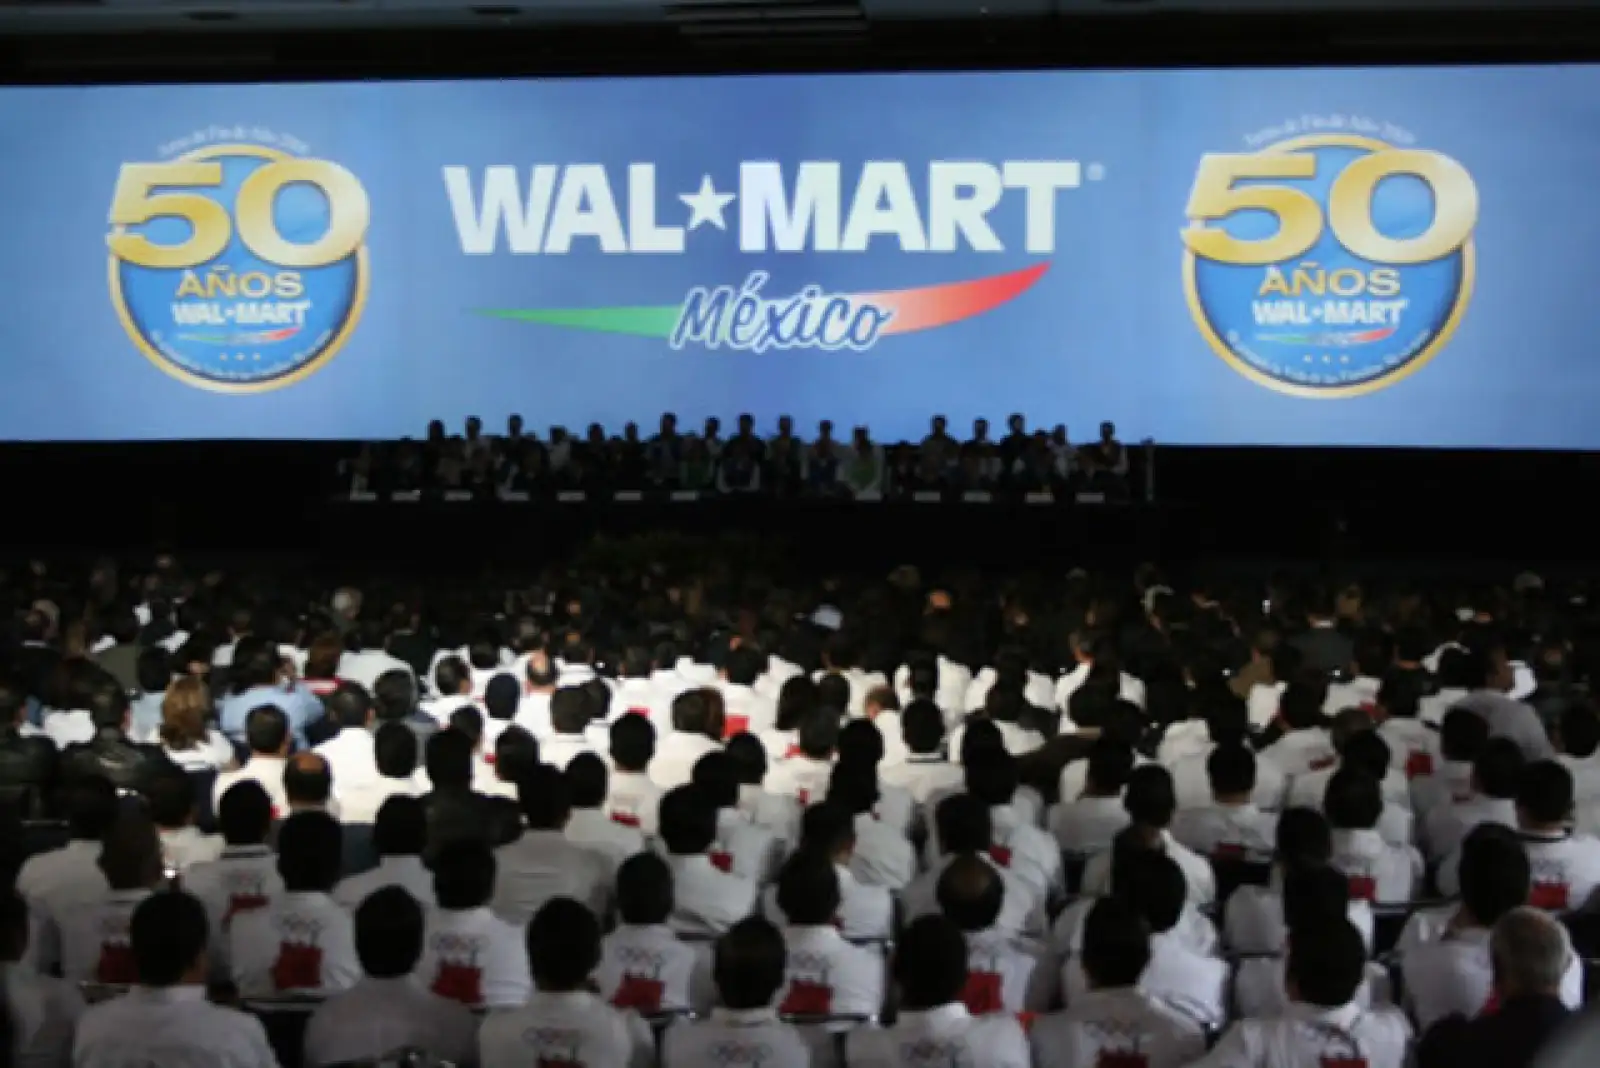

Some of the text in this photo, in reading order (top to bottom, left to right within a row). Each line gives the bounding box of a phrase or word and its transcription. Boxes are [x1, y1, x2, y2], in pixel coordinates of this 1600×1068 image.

[107, 161, 369, 266] 50
[1180, 151, 1478, 263] 50
[178, 266, 303, 298] AÑOS
[669, 271, 894, 353] México
[1259, 262, 1401, 296] AÑOS
